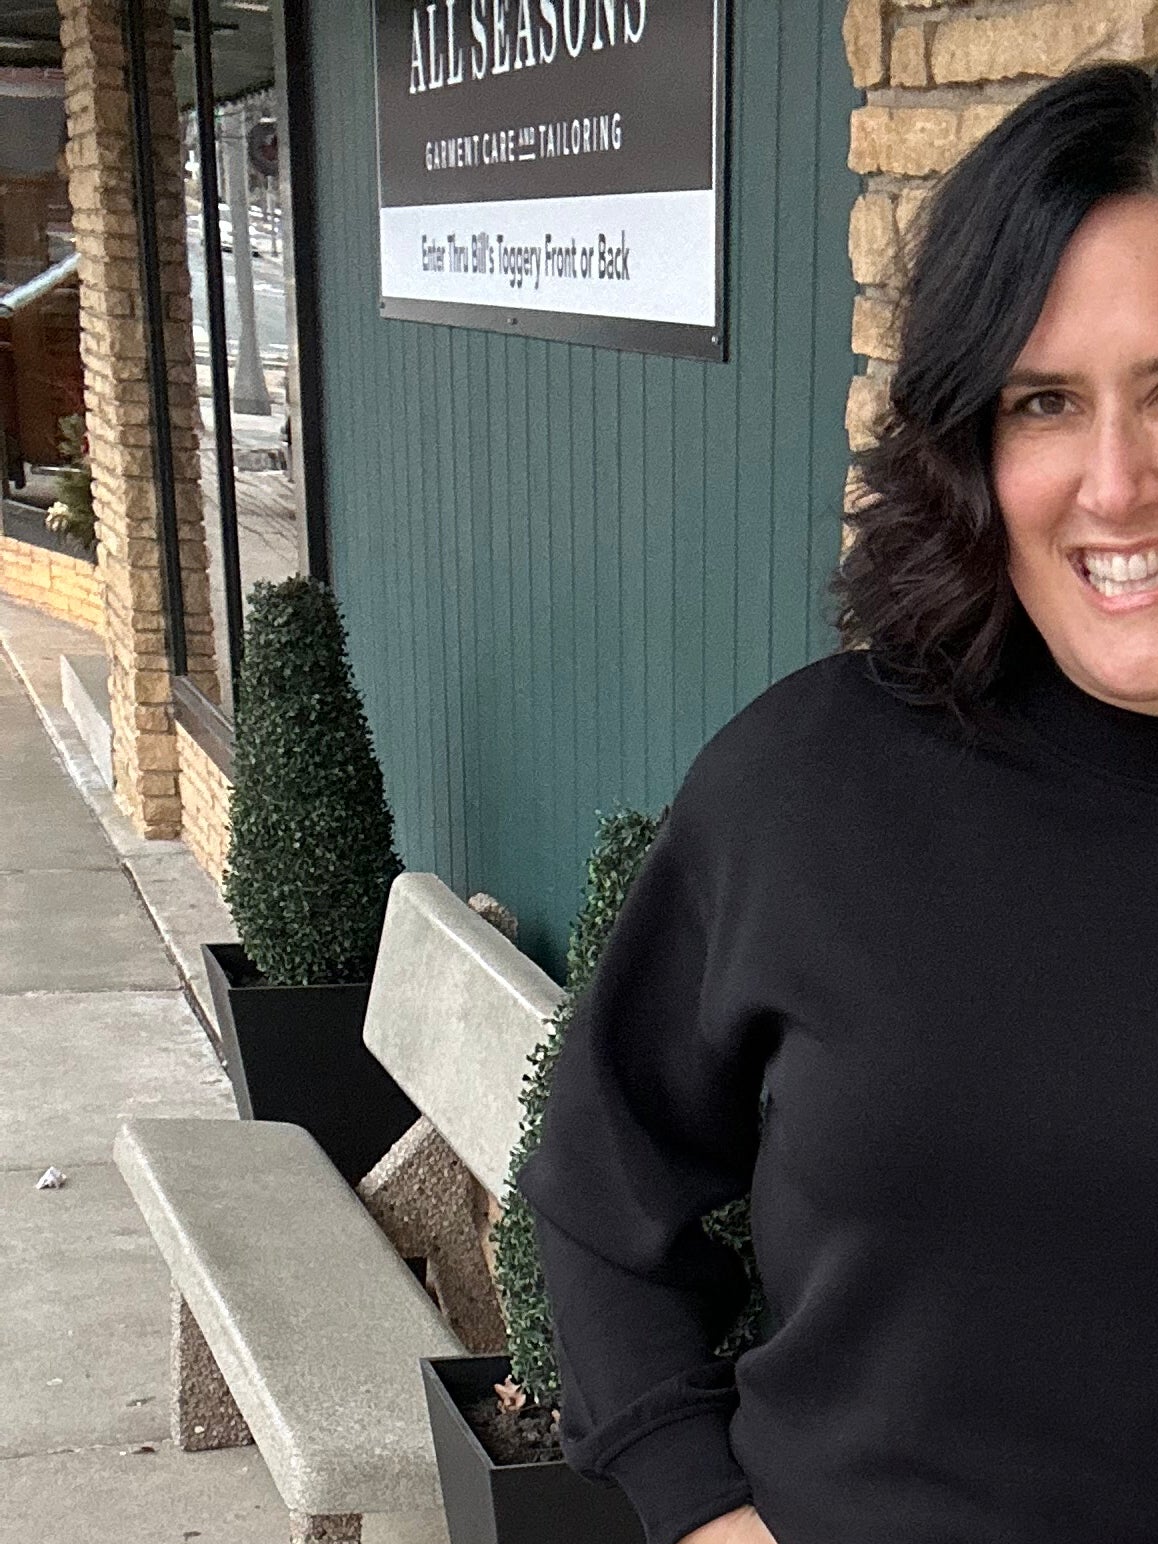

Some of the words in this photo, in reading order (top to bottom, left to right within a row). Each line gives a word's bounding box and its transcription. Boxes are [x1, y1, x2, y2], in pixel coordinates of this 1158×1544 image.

[409, 0, 463, 94] ALL
[425, 134, 479, 171] GARMENT
[482, 129, 515, 165] CARE
[518, 126, 536, 149] AND
[538, 112, 622, 158] TAILORING
[421, 234, 446, 272] Enter
[447, 233, 469, 273] Thru
[471, 231, 495, 274] Bill's
[496, 234, 542, 290] Toggery
[545, 233, 577, 278] Front
[580, 246, 595, 279] or
[598, 229, 630, 281] Back
